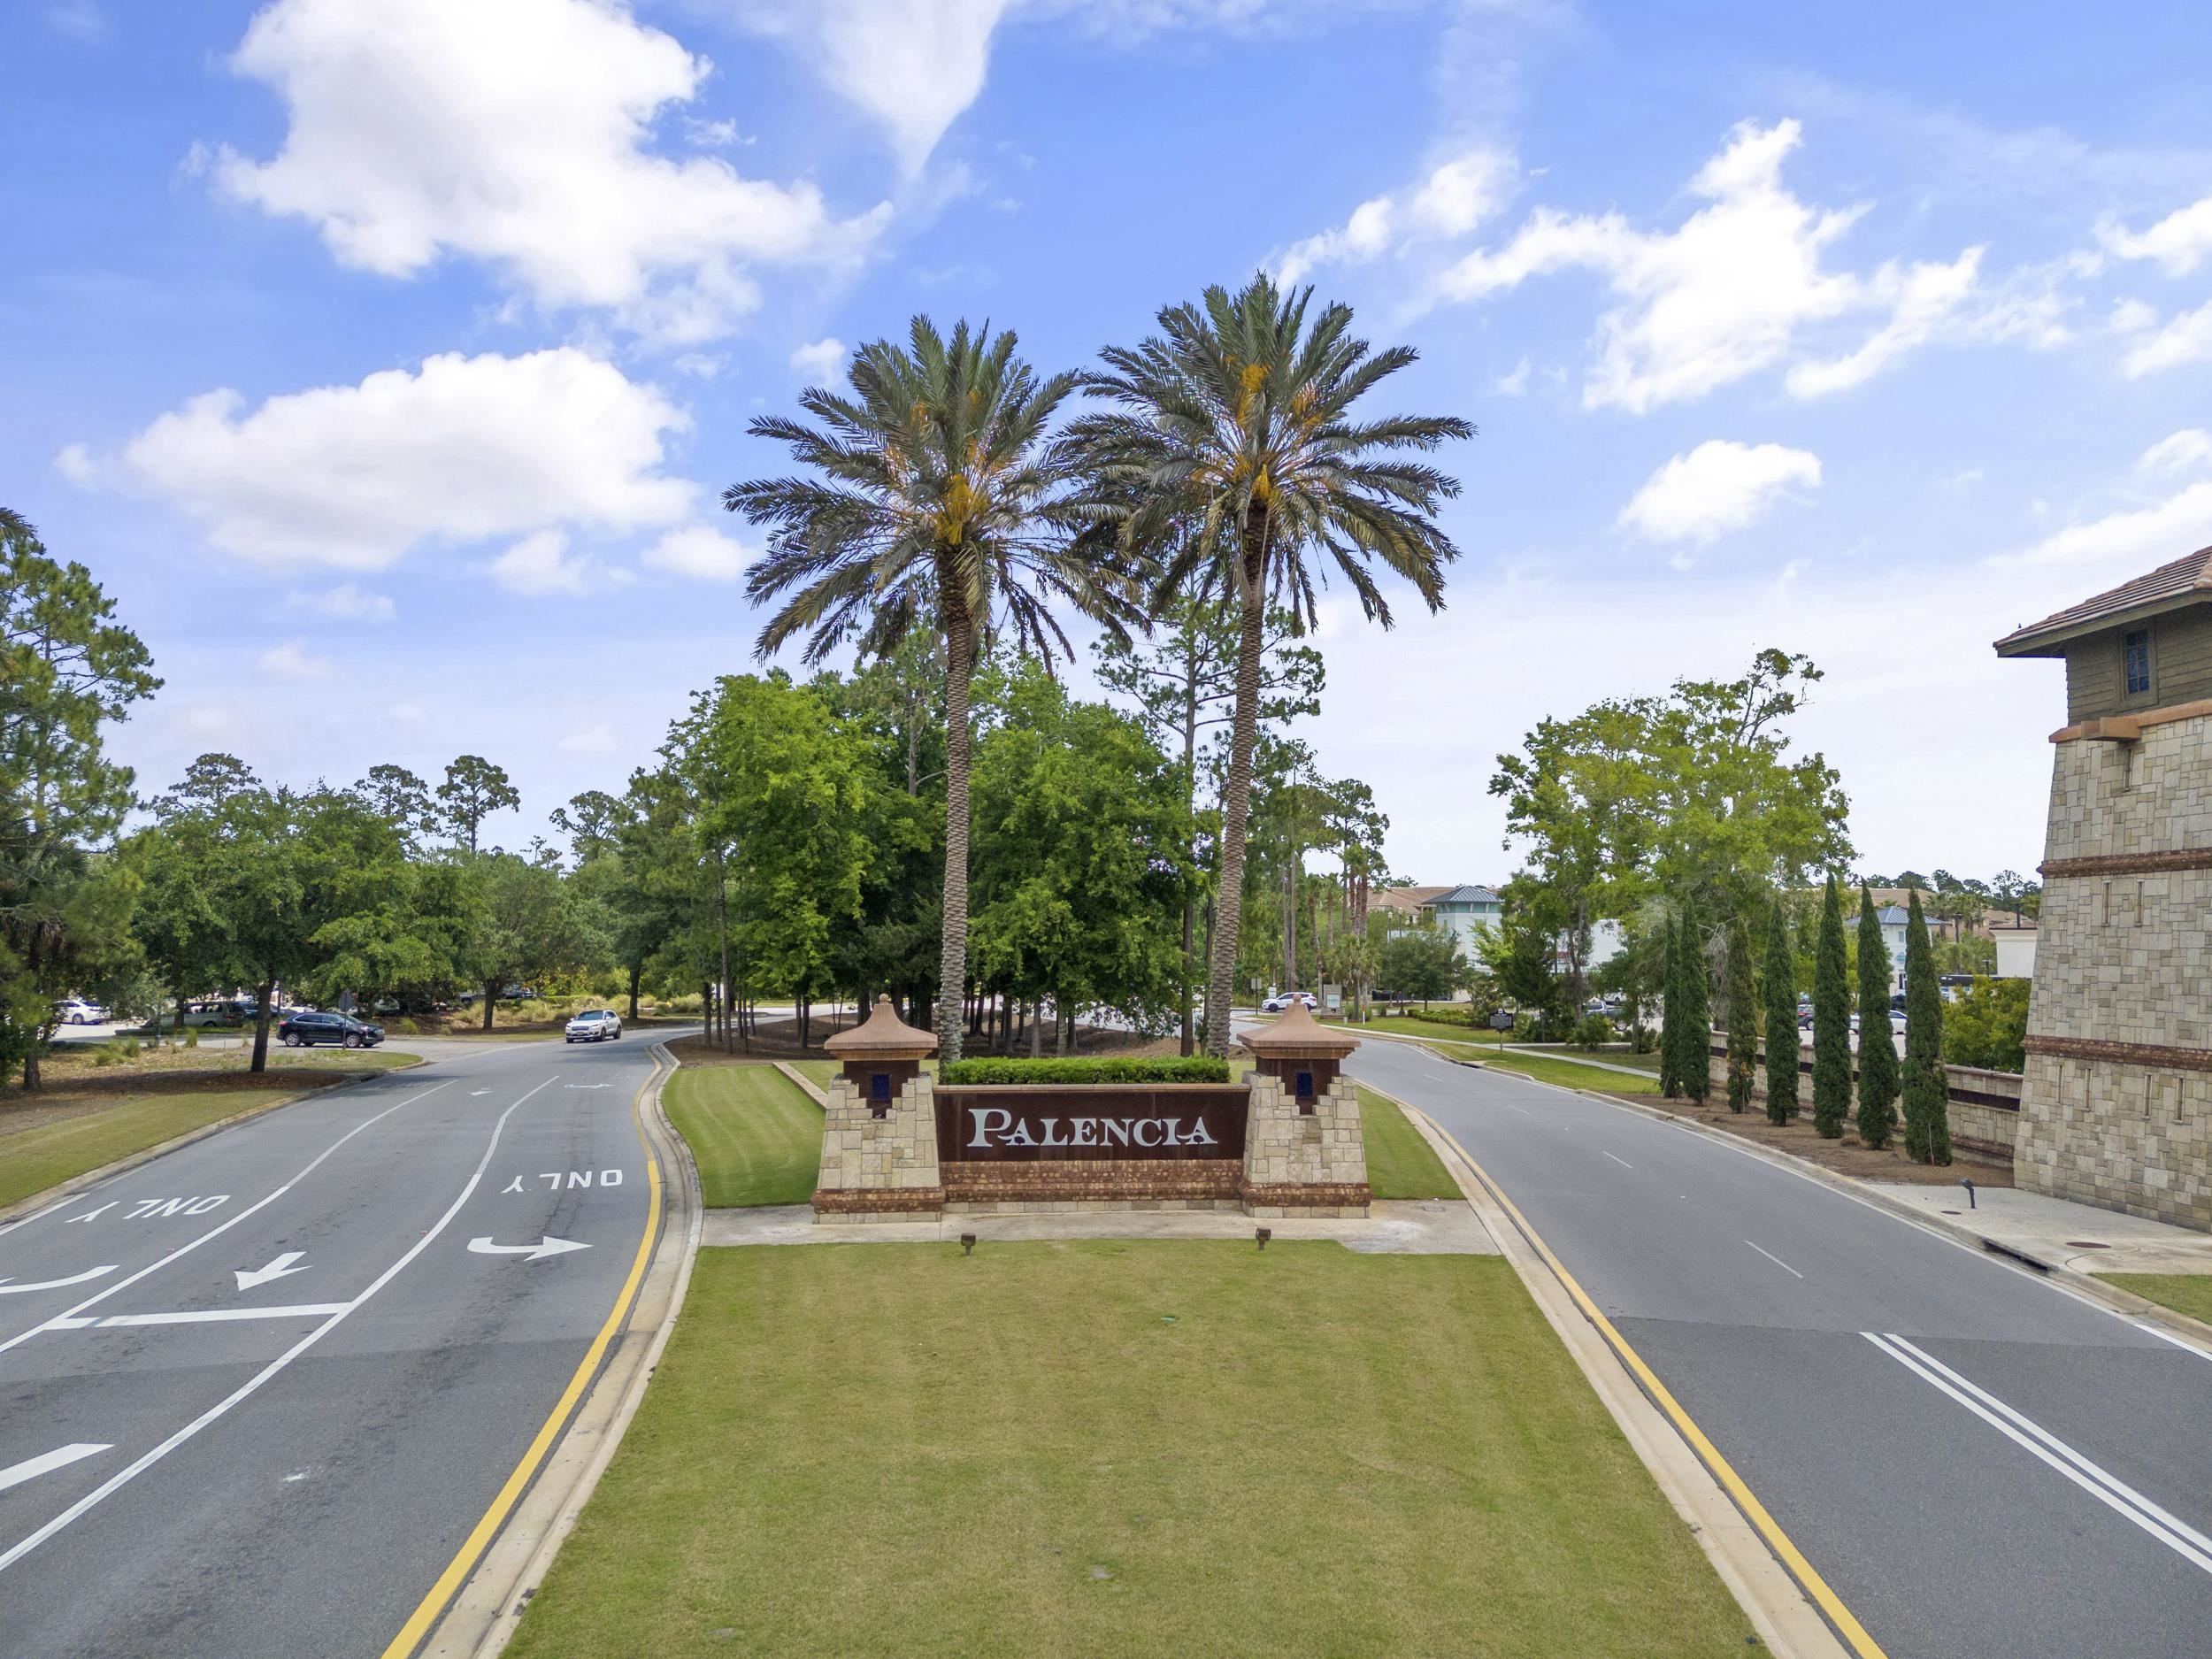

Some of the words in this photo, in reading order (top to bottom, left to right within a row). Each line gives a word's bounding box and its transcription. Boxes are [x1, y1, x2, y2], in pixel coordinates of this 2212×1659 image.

[967, 1109, 1218, 1148] PALENCIA
[501, 1169, 623, 1194] ONLY
[64, 1194, 232, 1223] ONLY
